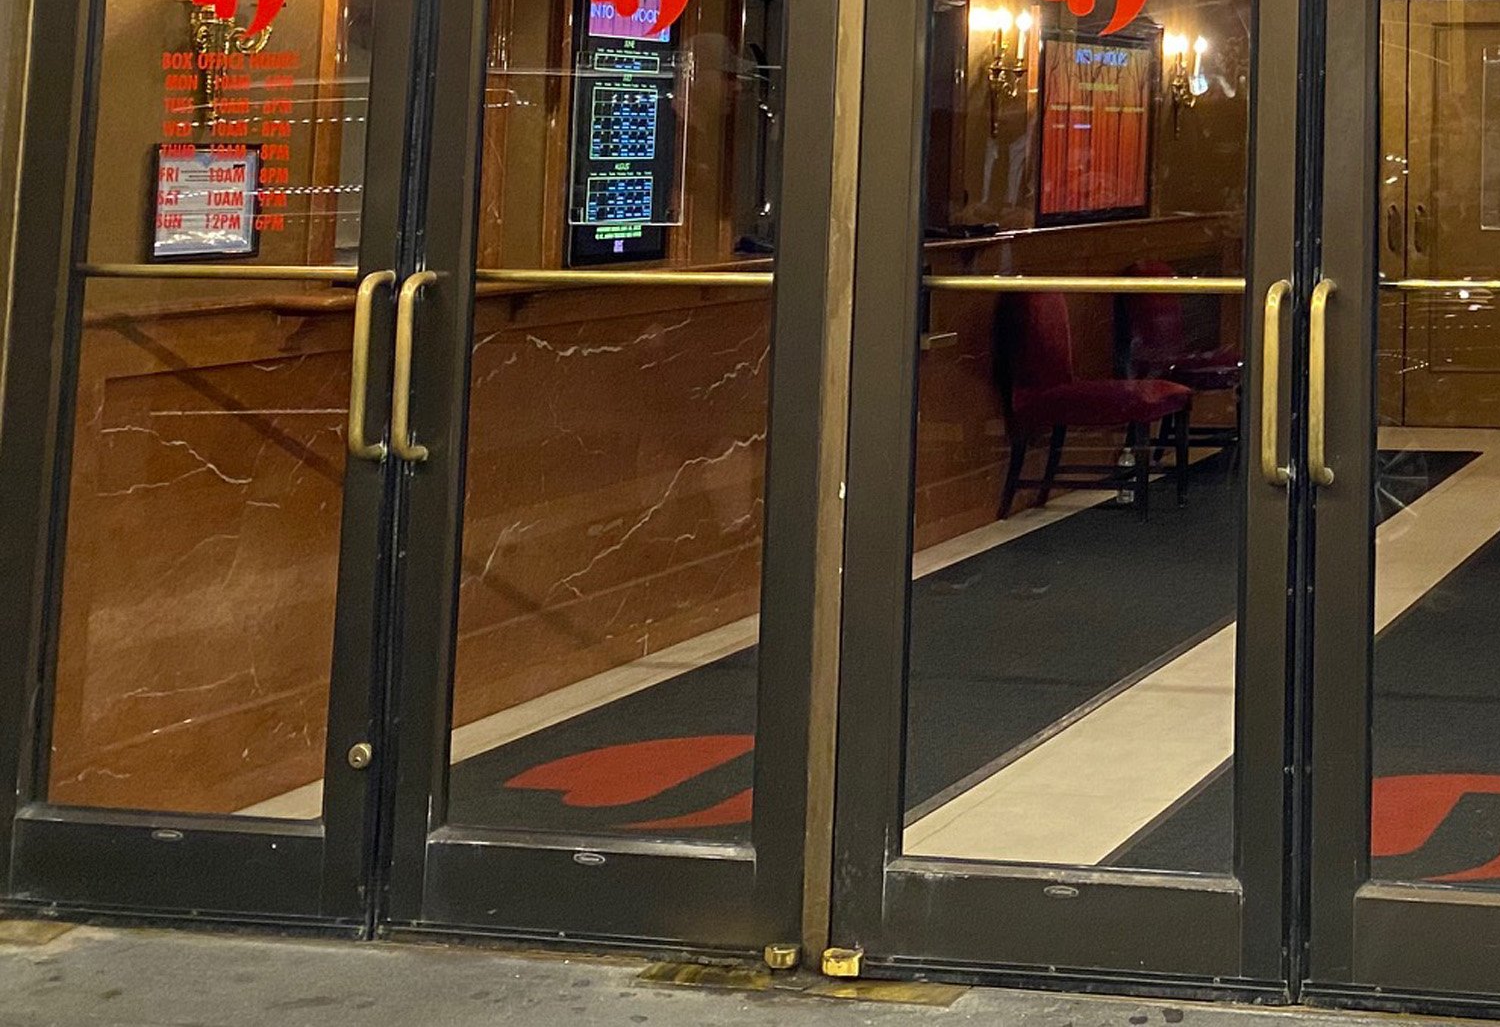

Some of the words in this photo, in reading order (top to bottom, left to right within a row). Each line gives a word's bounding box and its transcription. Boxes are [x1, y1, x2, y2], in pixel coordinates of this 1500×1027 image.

[158, 167, 180, 182] FRI
[208, 166, 245, 183] 10AM
[157, 190, 180, 206] SAT
[206, 190, 243, 206] 10AM
[156, 213, 183, 229] SUN
[204, 213, 240, 229] 12PM
